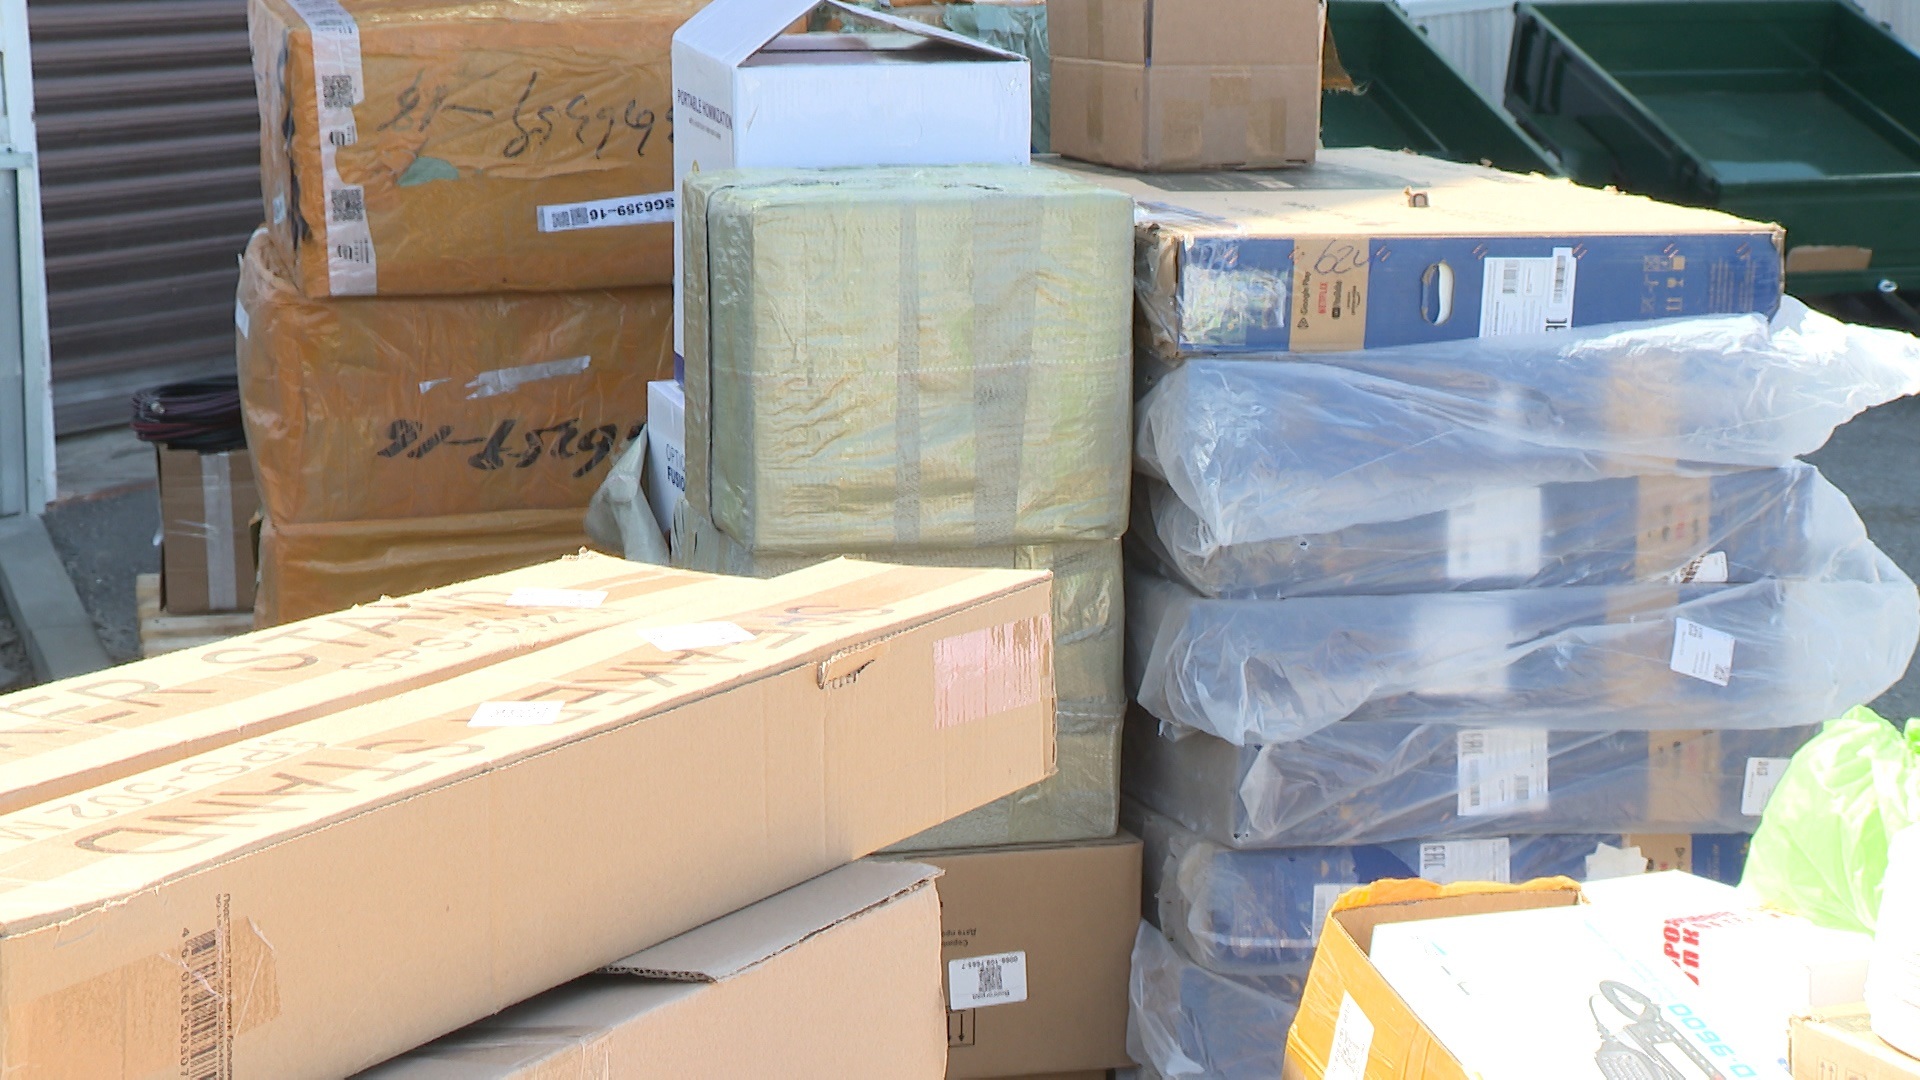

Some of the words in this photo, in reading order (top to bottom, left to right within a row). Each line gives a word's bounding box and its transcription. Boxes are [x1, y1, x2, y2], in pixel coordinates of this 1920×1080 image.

[677, 87, 702, 114] PORTABLE
[1301, 287, 1310, 315] Google
[201, 591, 545, 673] STAND
[74, 738, 487, 854] STAND
